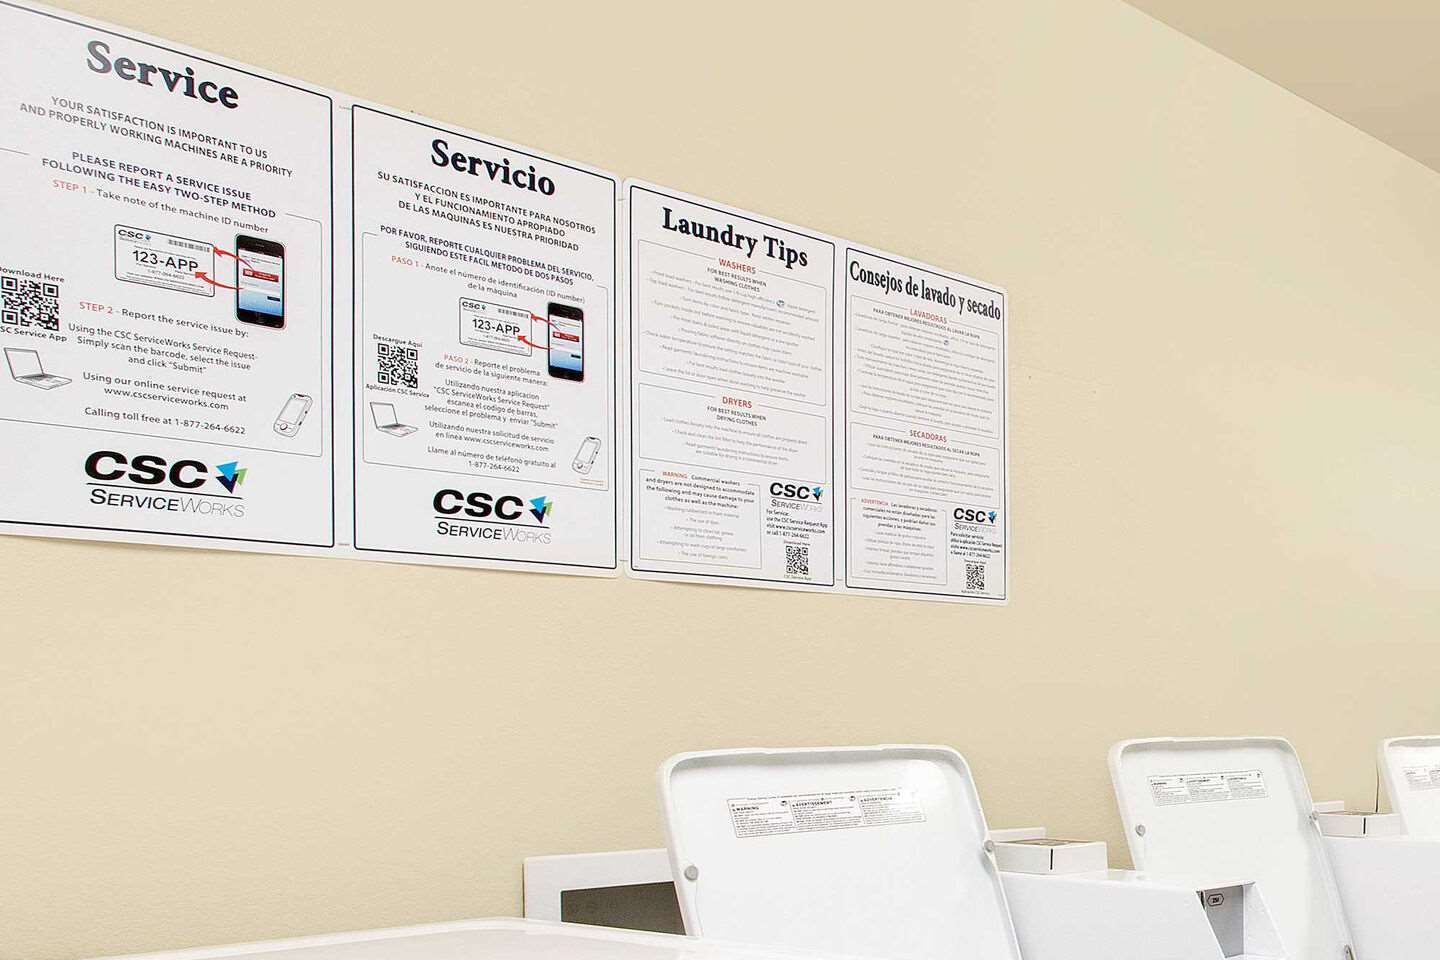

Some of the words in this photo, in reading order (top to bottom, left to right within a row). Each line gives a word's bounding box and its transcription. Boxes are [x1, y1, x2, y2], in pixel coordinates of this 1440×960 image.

[87, 40, 238, 108] Service
[20, 103, 45, 120] AND
[49, 110, 106, 134] PROPERLY
[110, 125, 162, 147] WORKING
[165, 138, 218, 161] MACHINES
[220, 151, 239, 166] ARE
[241, 156, 248, 168] A
[250, 158, 293, 178] PRIORITY
[52, 96, 84, 114] YOUR
[87, 105, 164, 133] SATISFACTION
[167, 125, 176, 136] IS
[179, 127, 237, 151] IMPORTANT
[240, 142, 253, 155] TO
[255, 146, 267, 159] US
[72, 152, 116, 171] PLEASE
[119, 162, 162, 181] REPORT
[166, 173, 173, 184] A
[176, 175, 219, 194] SERVICE
[222, 185, 251, 200] ISSUE
[431, 139, 555, 196] Servicio
[42, 159, 115, 184] FOLLOWING
[118, 175, 140, 189] THE
[143, 181, 172, 196] EASY
[175, 187, 229, 208] TWO-STEP
[232, 200, 276, 218] METHOD
[53, 179, 79, 195] STEP
[81, 185, 87, 196] 1
[97, 188, 120, 203] Take
[123, 193, 145, 208] note
[148, 198, 158, 211] of
[161, 201, 177, 215] the
[179, 204, 219, 224] machine
[221, 213, 231, 226] ID
[234, 215, 269, 234] number
[377, 171, 390, 183] SU
[392, 175, 458, 200] SATISFACCION
[460, 192, 470, 203] ES
[472, 195, 527, 217] IMPORTANTE
[530, 209, 550, 223] PARA
[553, 215, 595, 234] NOSOTROS
[399, 201, 411, 211] DE
[413, 204, 430, 216] LAS
[432, 209, 480, 228] MAQUINAS
[483, 220, 492, 230] ES
[494, 223, 532, 240] NUESTRA
[535, 233, 579, 250] PRIORIDAD
[415, 193, 421, 202] Y
[423, 195, 433, 205] EL
[435, 198, 515, 225] FUNCIONAMIENTO
[517, 217, 565, 237] APROPIADO
[118, 229, 143, 241] CSC
[662, 207, 757, 258] Laundry
[763, 235, 808, 269] Tips
[133, 250, 198, 272] 123-APP
[719, 258, 756, 274] WASHERS
[850, 261, 902, 295] Consejos
[906, 276, 918, 297] de
[921, 280, 956, 307] lavado
[959, 296, 964, 315] y
[967, 300, 1000, 320] secado
[472, 318, 520, 336] 123-APP
[910, 309, 947, 324] LAVADORAS
[104, 387, 229, 411] www.cscserviceworks.com
[722, 397, 752, 408] DRYERS
[85, 407, 119, 421] Calling
[123, 411, 139, 423] toll
[142, 414, 160, 425] free
[163, 416, 172, 427] at
[175, 417, 246, 435] 1-877-264-6622
[910, 430, 947, 442] SECADORAS
[84, 451, 208, 488] CSC
[433, 489, 523, 520] CSC
[770, 482, 810, 499] CSC
[953, 508, 986, 522] CSC
